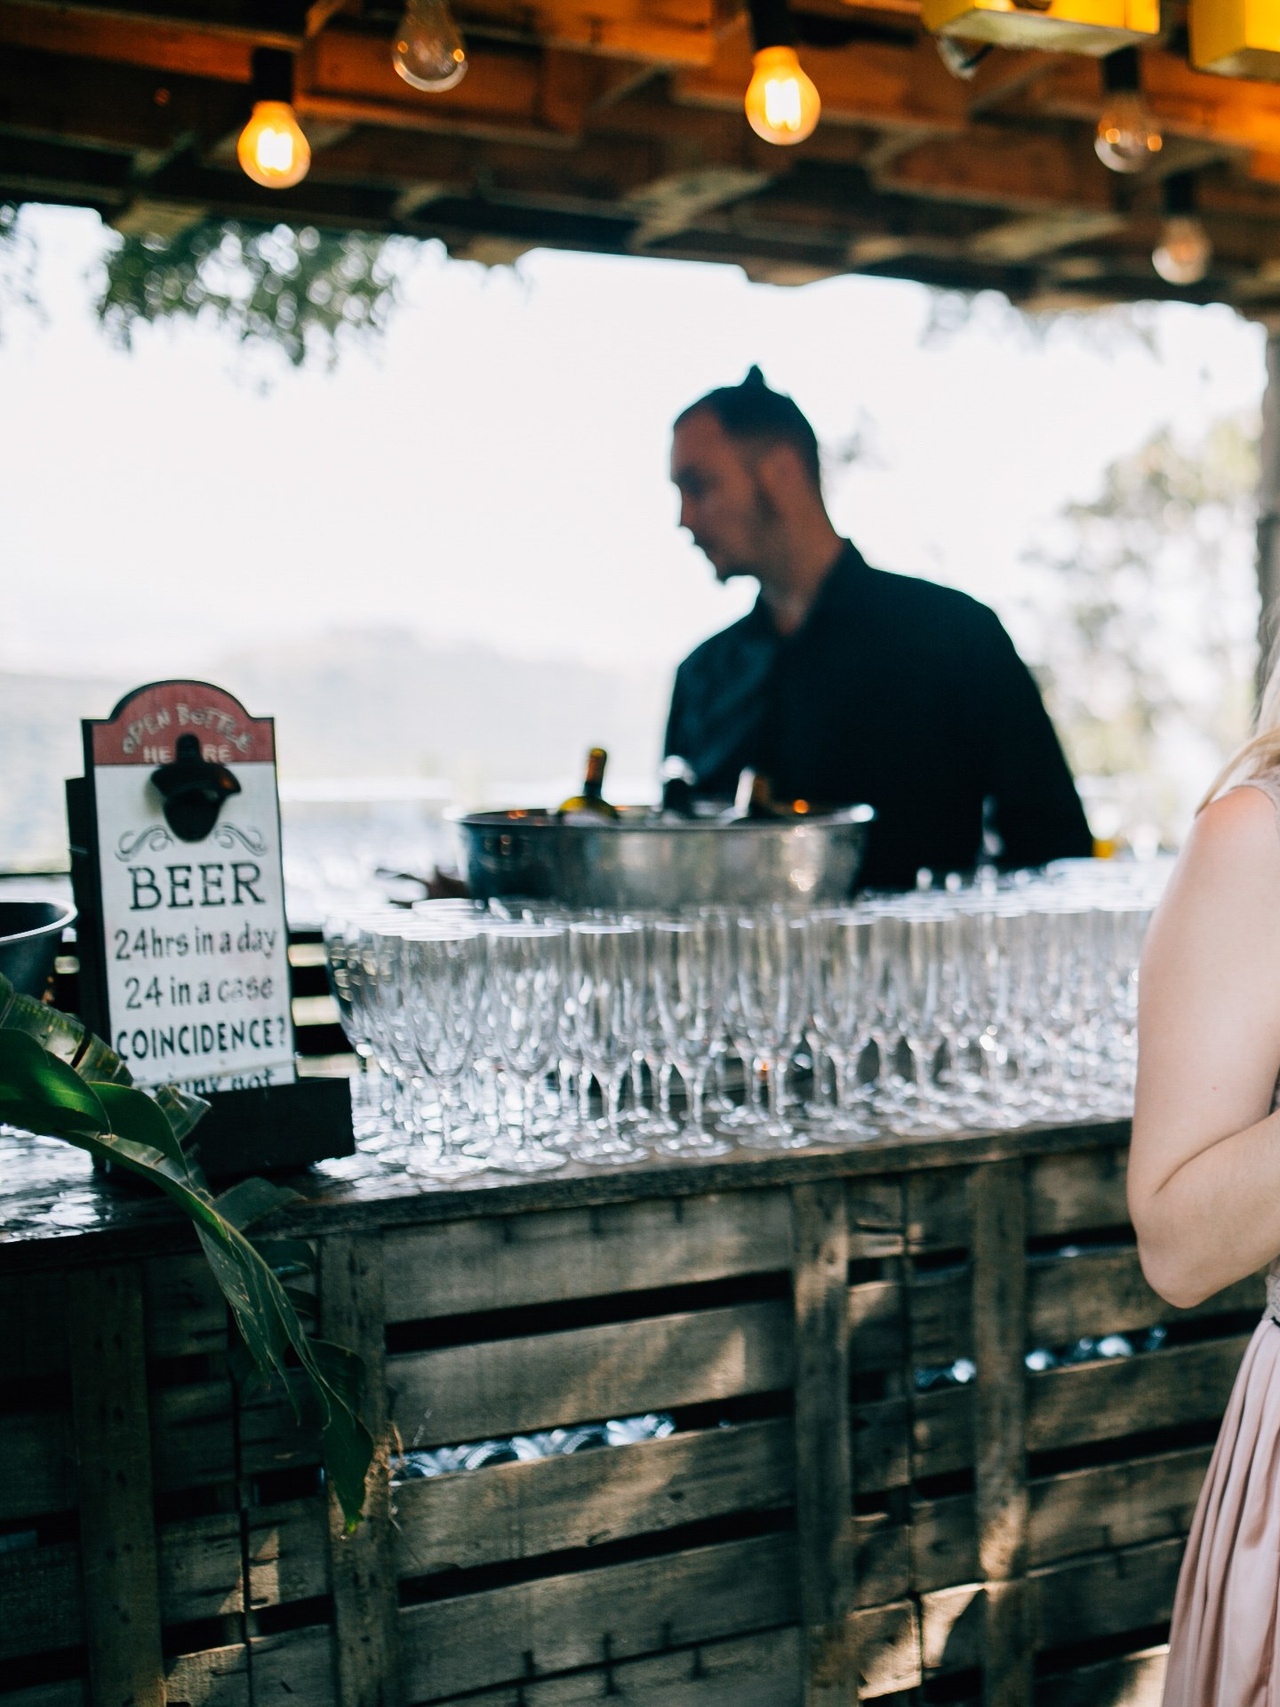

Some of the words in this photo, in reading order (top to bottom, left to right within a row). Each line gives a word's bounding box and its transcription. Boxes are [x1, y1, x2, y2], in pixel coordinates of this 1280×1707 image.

[122, 707, 171, 754] OPEN
[127, 861, 265, 911] BEER
[114, 928, 189, 961] 24hrs
[194, 926, 213, 956] in
[218, 930, 232, 953] a
[237, 920, 278, 959] day
[124, 976, 162, 1010] 24
[169, 976, 191, 1005] in
[197, 979, 212, 1004] a
[217, 975, 273, 1003] case
[115, 1014, 286, 1062] COINCIDENCE?
